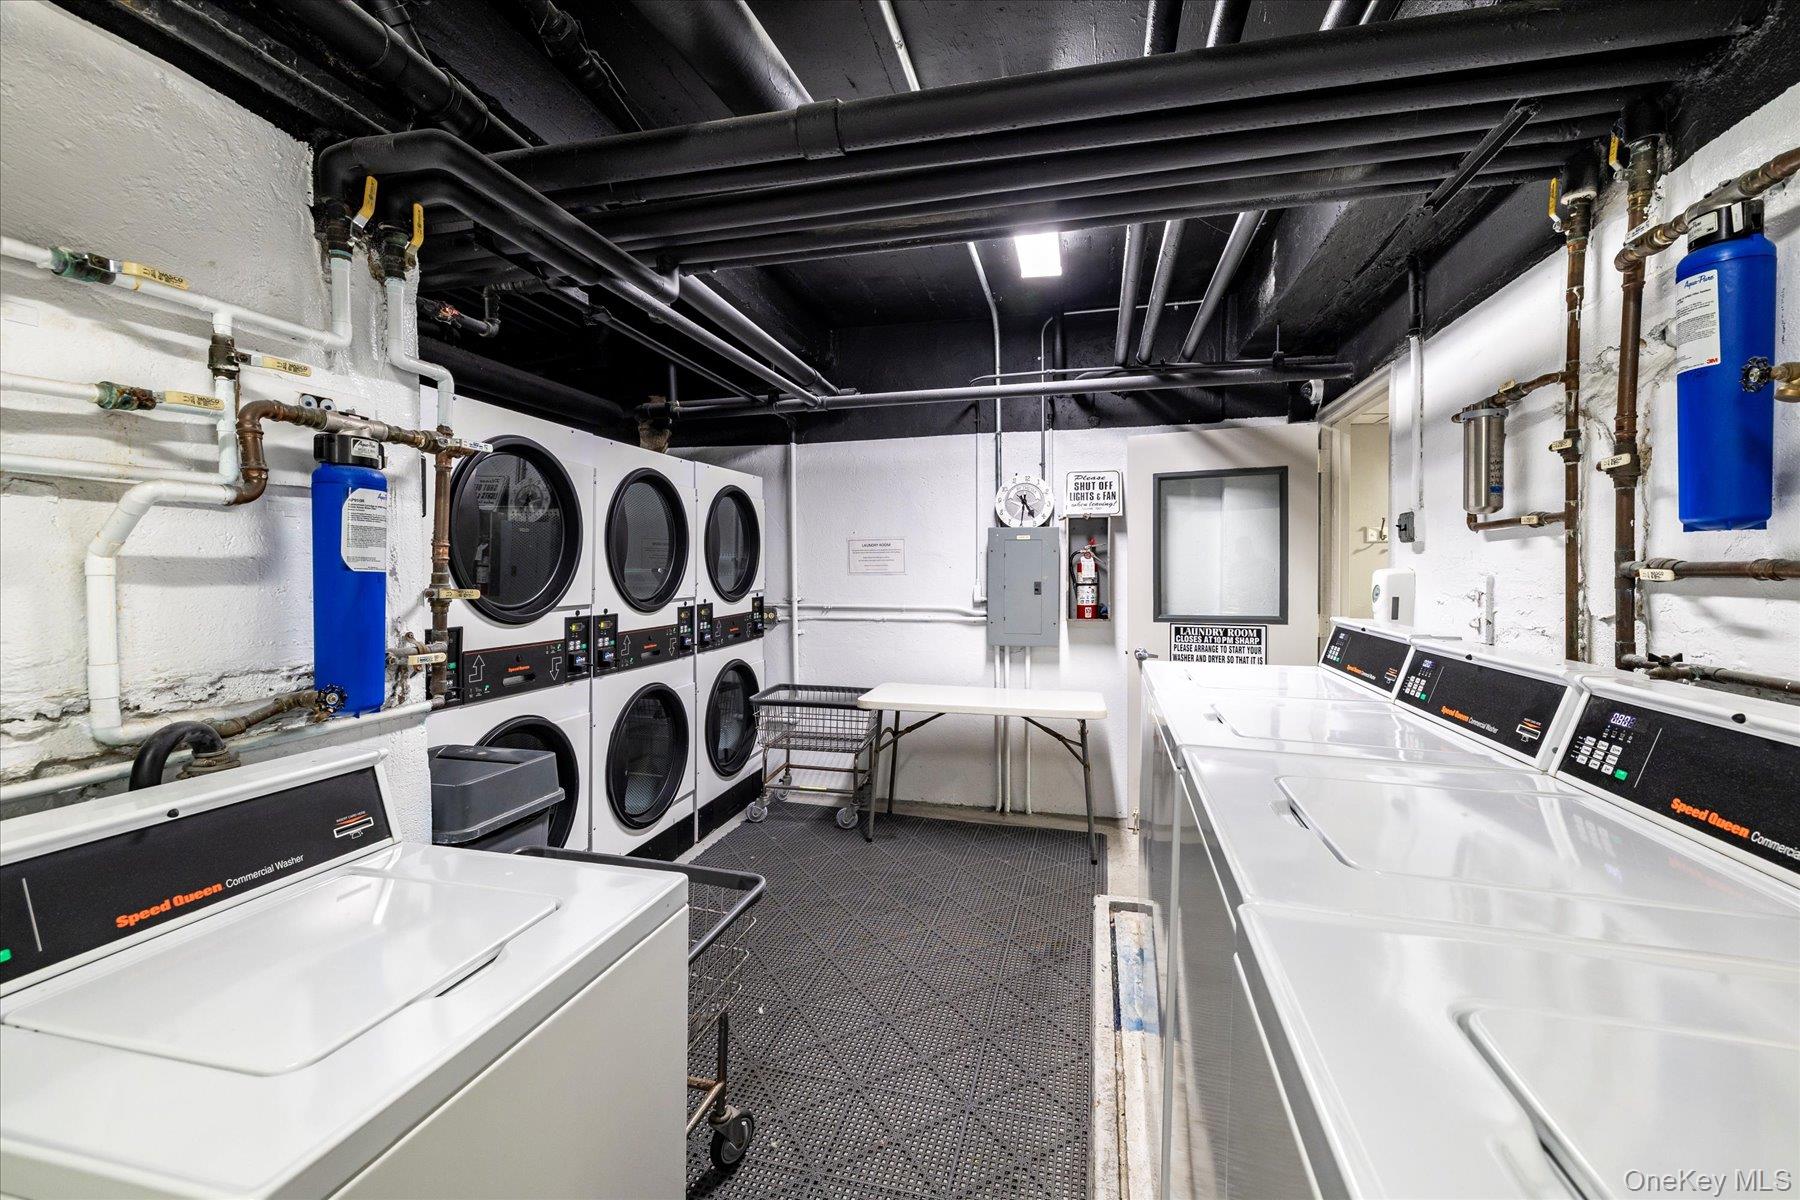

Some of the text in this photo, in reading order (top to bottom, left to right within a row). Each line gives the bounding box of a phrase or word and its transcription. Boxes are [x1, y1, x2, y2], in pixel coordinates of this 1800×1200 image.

[1074, 481, 1113, 491] SHUT OFF
[1070, 492, 1094, 501] LIGHTS
[1103, 491, 1116, 500] FAN
[1180, 627, 1257, 637] LAUNDRY ROOM
[1175, 635, 1202, 643] CLOSES
[1234, 637, 1260, 645] SHARP
[1173, 644, 1262, 654] PLEASE ARRANGE TO START YOUR
[1172, 654, 1194, 662] WASHER
[1226, 656, 1234, 664] SO
[1235, 656, 1249, 664] THAT
[1257, 657, 1263, 665] IS
[1670, 797, 1800, 861] Speed Queen Commercia
[115, 854, 305, 929] Speed Queen Commercial Washer
